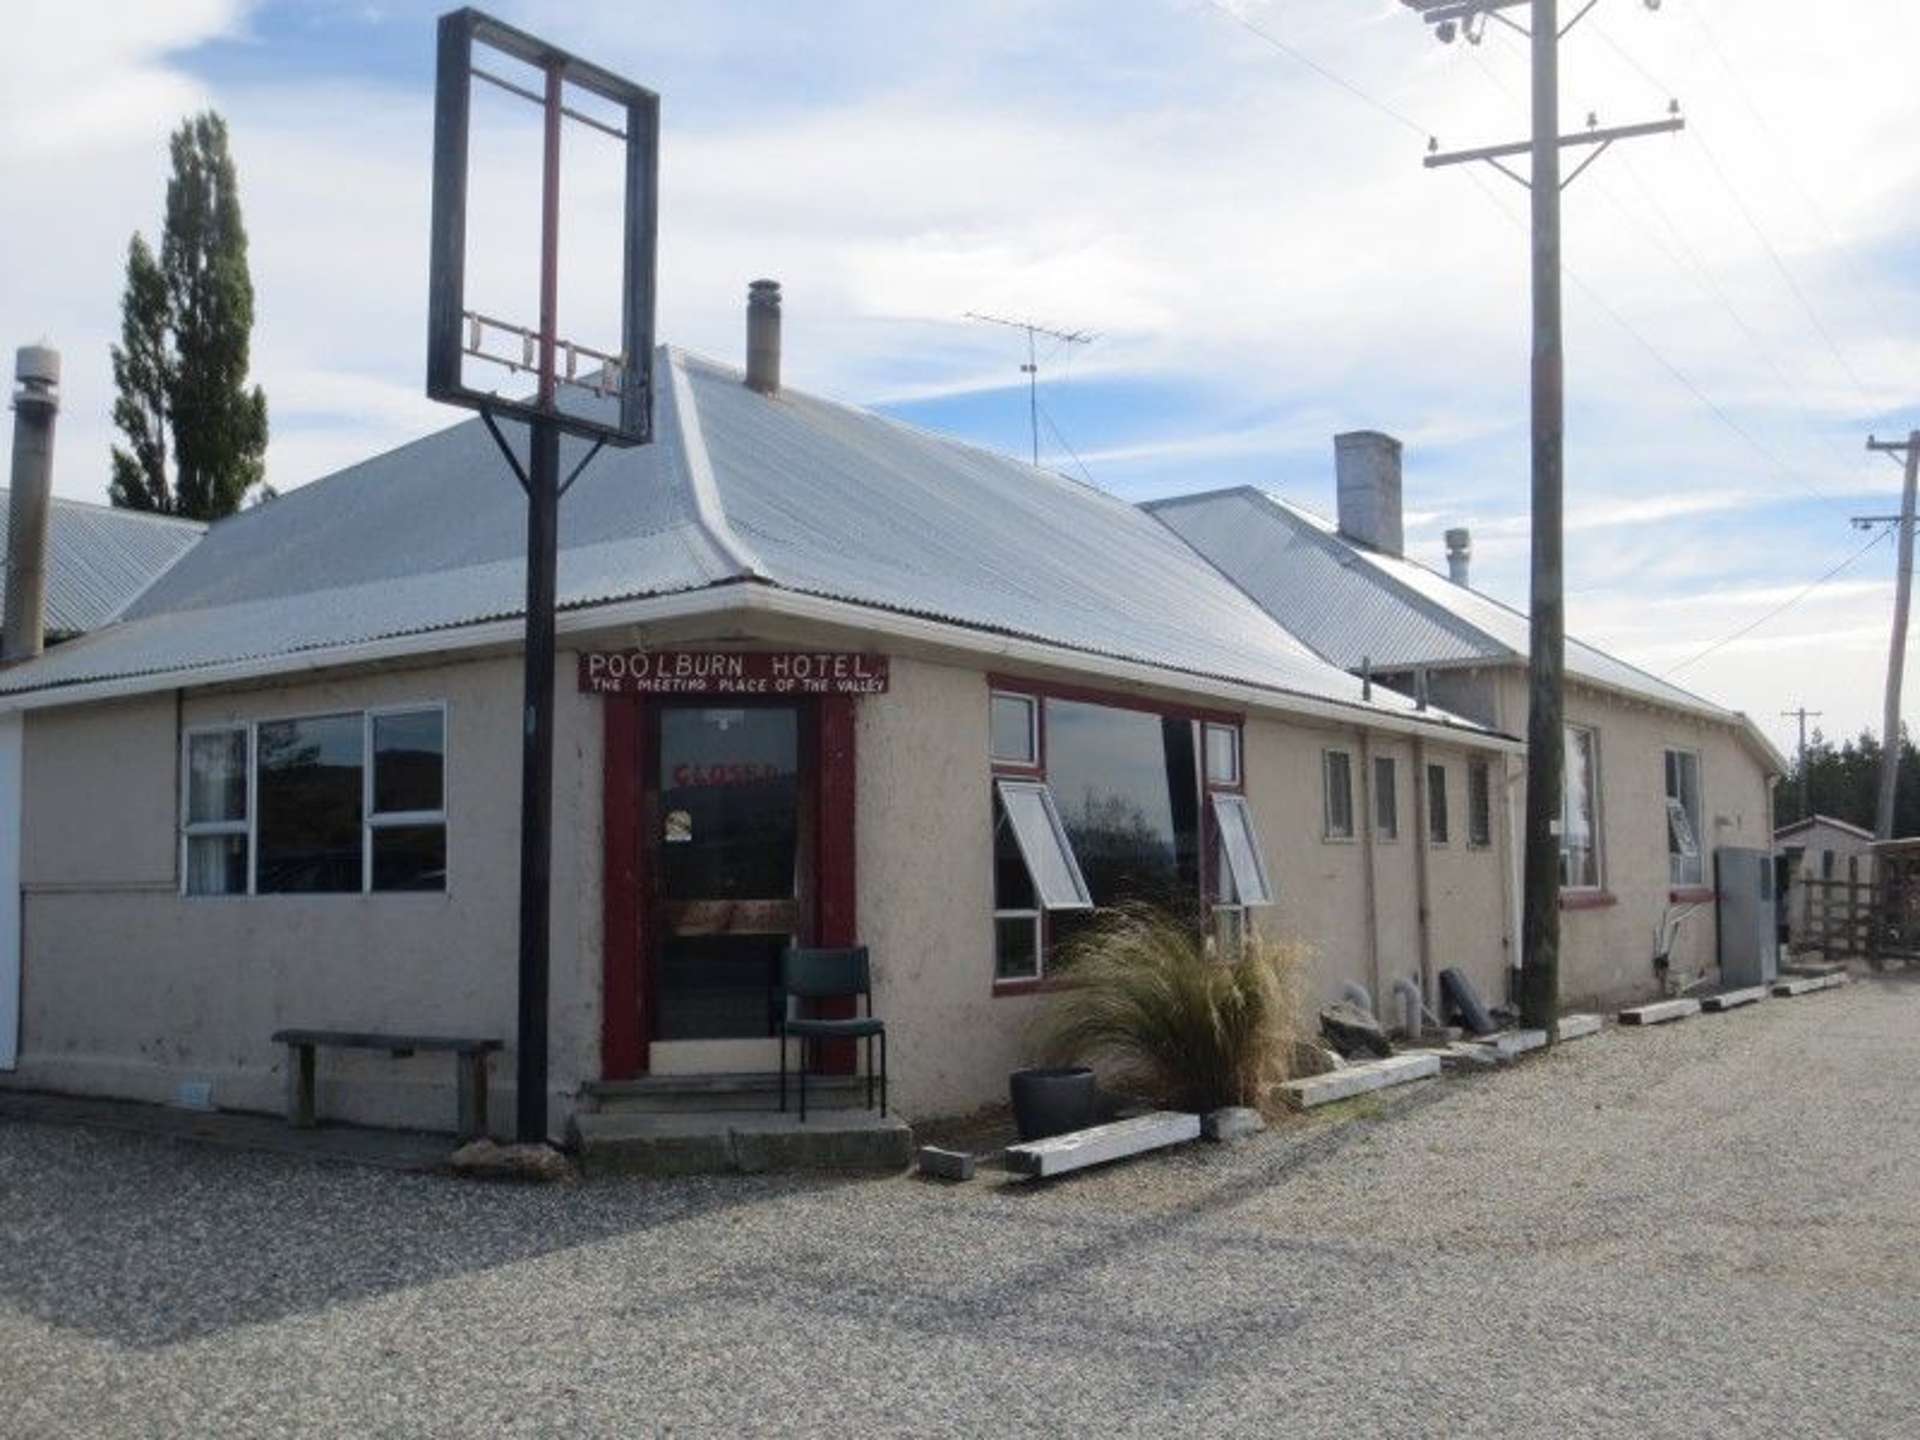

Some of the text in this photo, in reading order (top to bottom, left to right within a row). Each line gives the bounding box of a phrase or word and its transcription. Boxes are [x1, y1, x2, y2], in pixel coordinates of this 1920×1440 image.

[589, 653, 872, 678] POOLBURN HOTEL
[592, 678, 620, 691] THE
[719, 678, 767, 692] PLACE
[775, 678, 795, 692] OF
[803, 678, 829, 692] THE
[837, 678, 884, 692] VALLEY
